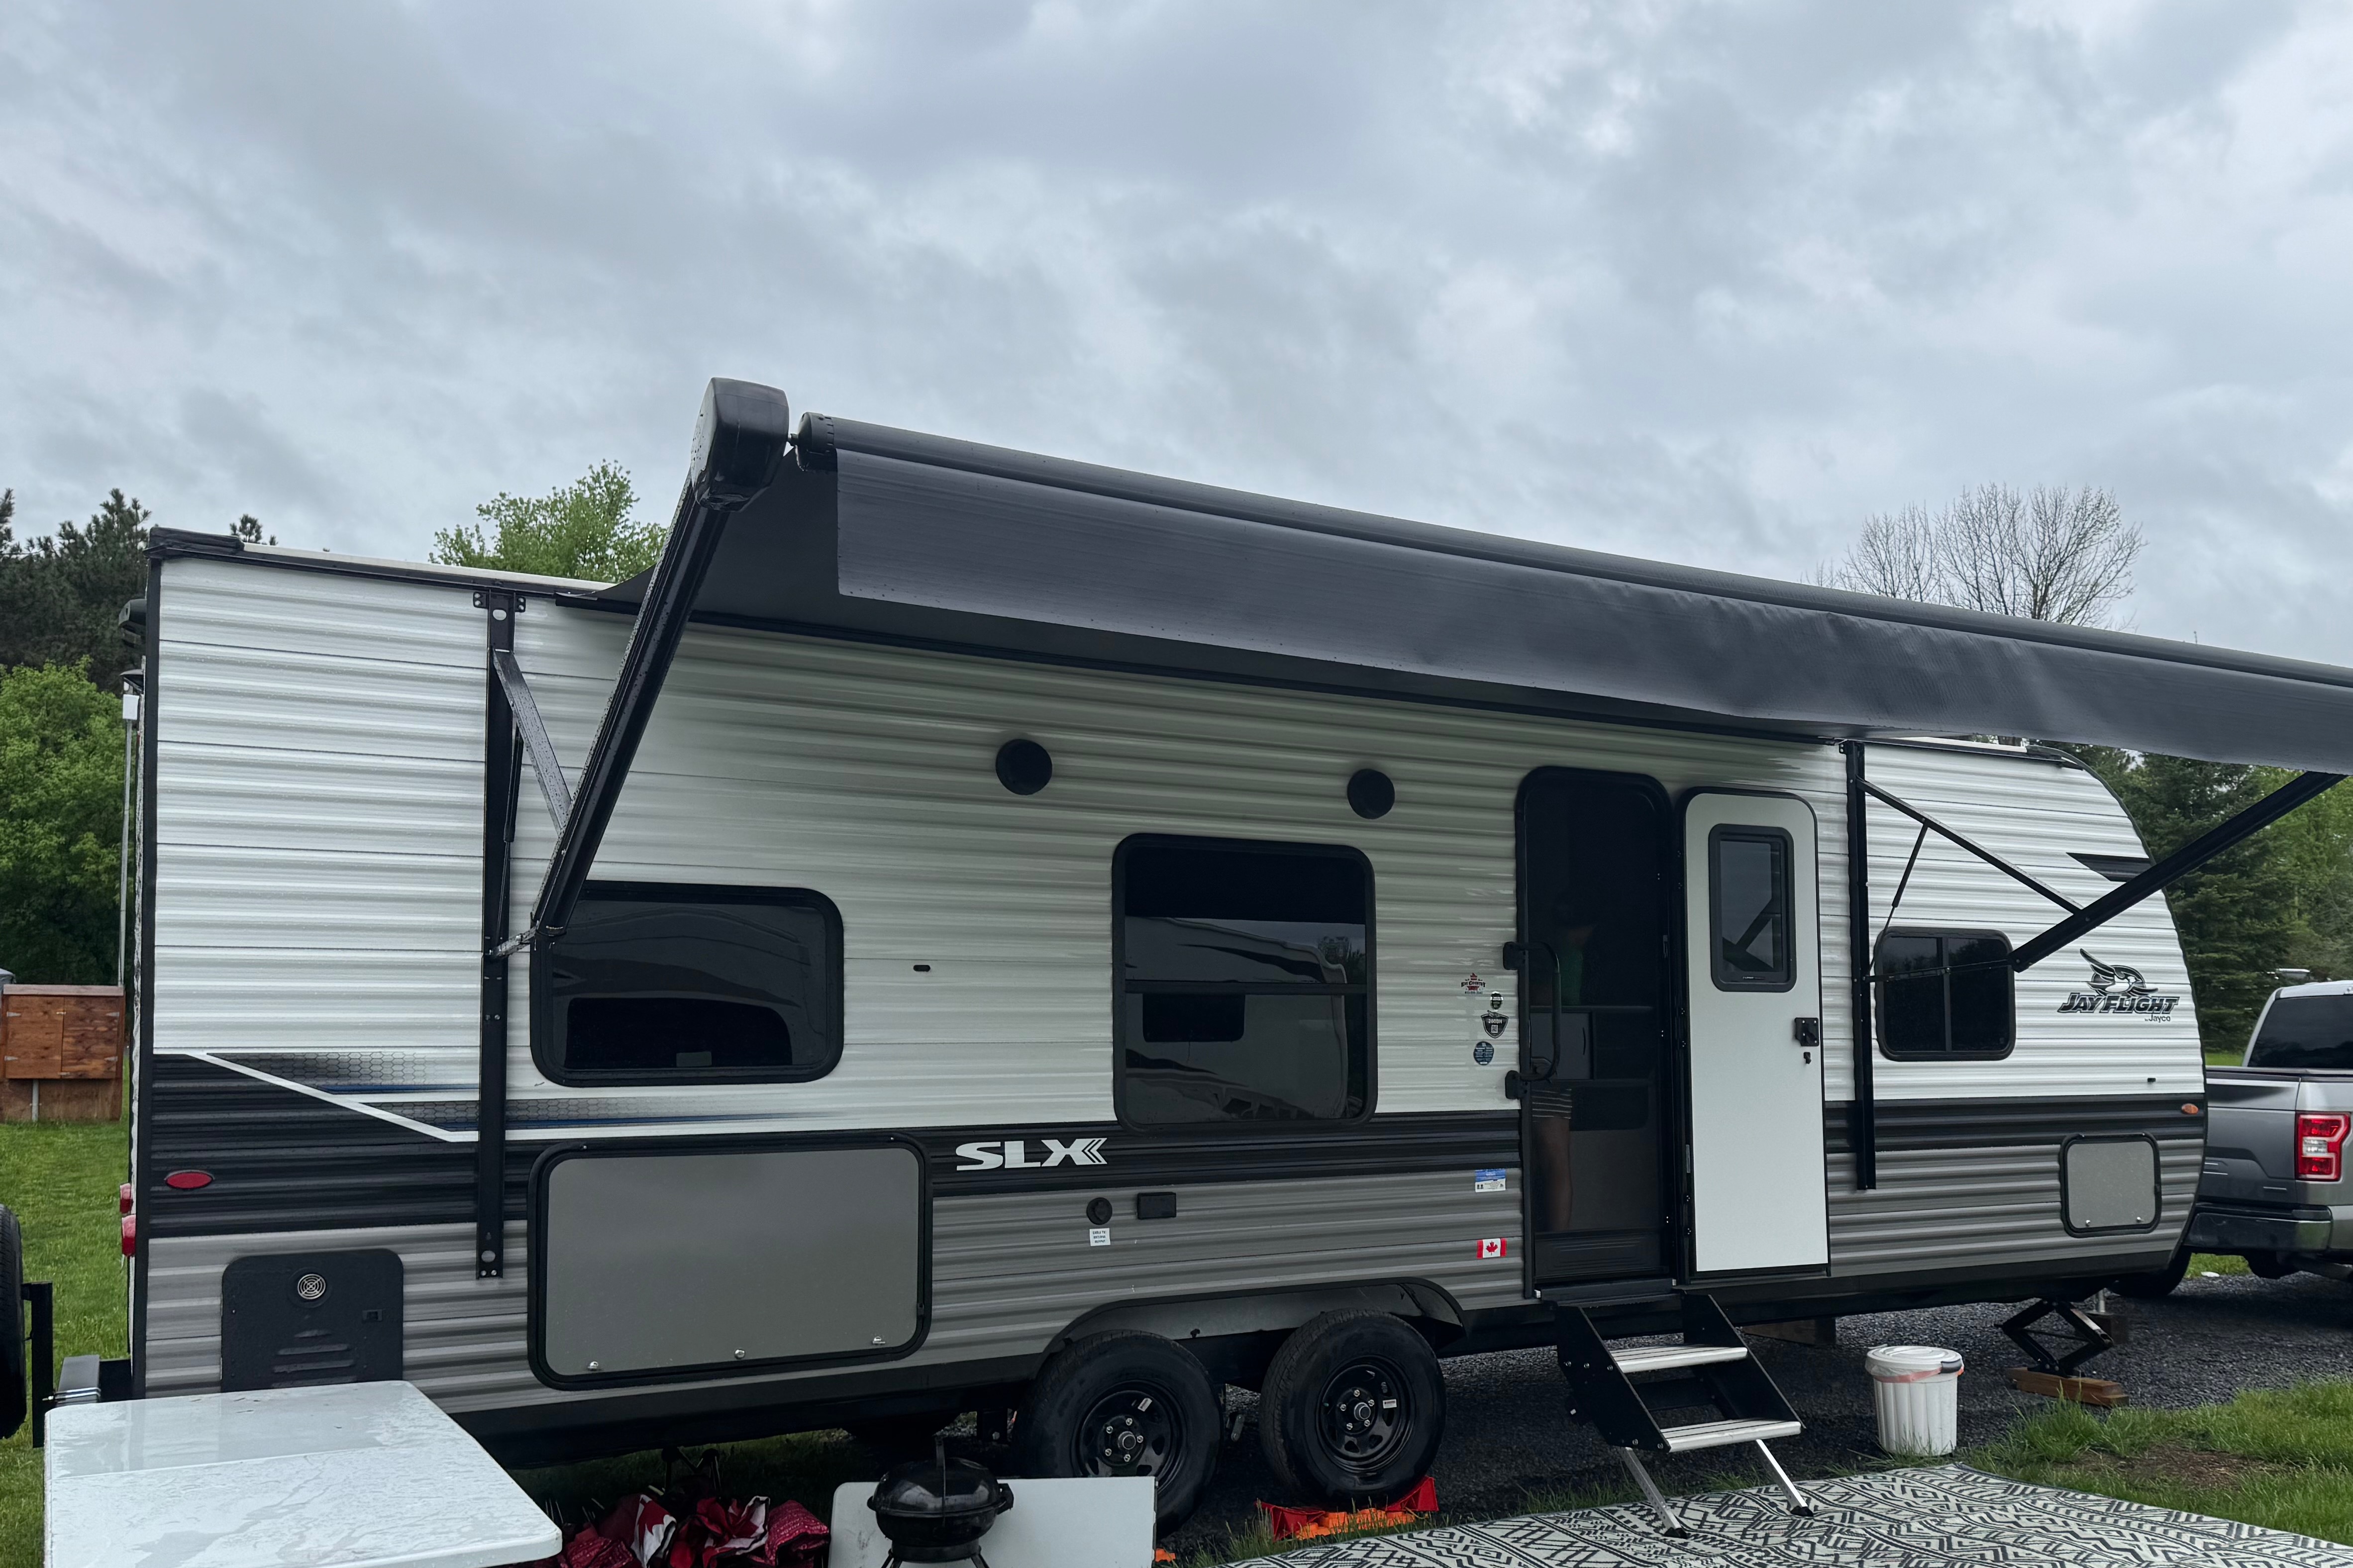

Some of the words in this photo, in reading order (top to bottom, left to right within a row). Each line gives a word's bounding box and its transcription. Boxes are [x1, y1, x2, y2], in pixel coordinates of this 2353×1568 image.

[2057, 993, 2105, 1013] JAY
[2099, 995, 2180, 1014] FLIGHT
[955, 1138, 1108, 1171] SLX
